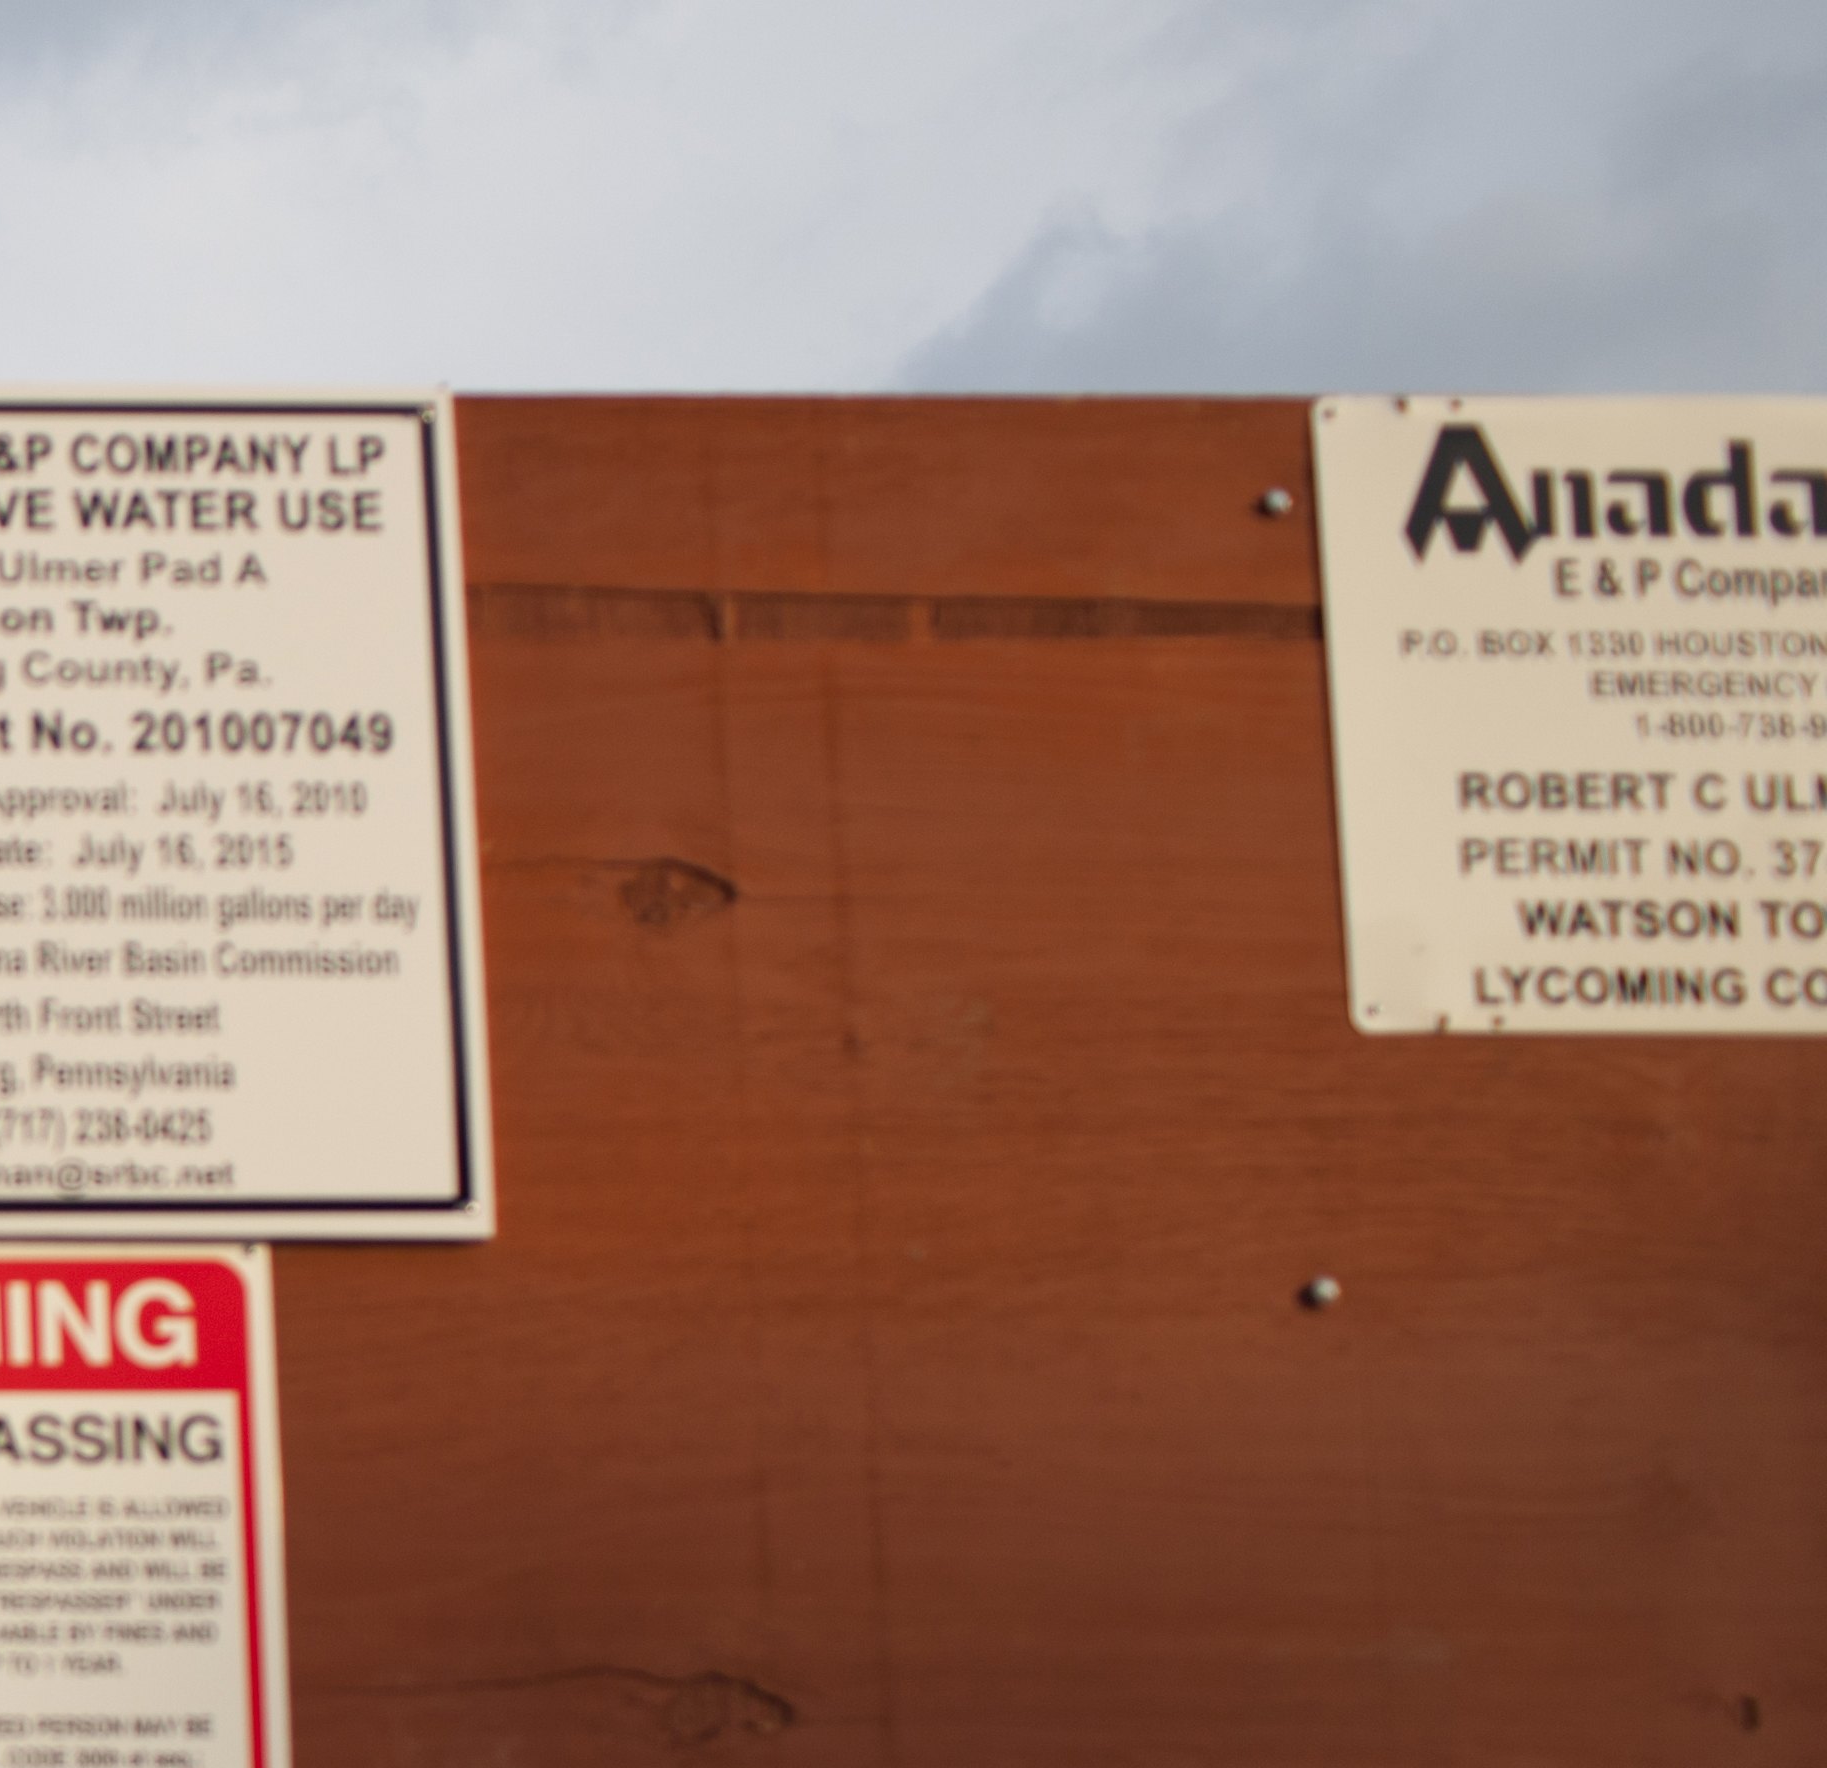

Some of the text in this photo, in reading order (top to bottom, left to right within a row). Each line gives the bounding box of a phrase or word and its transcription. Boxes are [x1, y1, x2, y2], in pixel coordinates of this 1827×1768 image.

[70, 434, 309, 476] COMPANY
[327, 436, 384, 477] LP
[73, 489, 257, 532] WATER
[277, 489, 380, 533] USE
[140, 551, 223, 586] Pad
[235, 554, 265, 586] A
[1554, 556, 1579, 598] E
[1594, 559, 1621, 598] &
[1636, 557, 1661, 596] P
[74, 601, 171, 643] Twp.
[1478, 629, 1554, 660] BOX
[21, 652, 189, 694] County,
[205, 650, 270, 687] Pa.
[1591, 668, 1818, 701] EMERGENCY
[31, 712, 111, 753] No.
[131, 710, 393, 755] 201007049
[157, 783, 222, 824] July
[293, 781, 370, 816] 2010
[1459, 771, 1672, 811] ROBERT
[1693, 772, 1725, 812] C
[74, 836, 141, 876] July
[215, 833, 291, 869] 2015
[1461, 836, 1646, 877] PERMIT
[1667, 837, 1755, 879] NO.
[119, 888, 206, 922] million
[216, 887, 312, 932] gallons
[321, 896, 361, 929] per
[371, 891, 418, 932] day
[1519, 898, 1827, 940] WATSON TO
[36, 942, 112, 976] River
[122, 943, 202, 977] Basin
[214, 942, 396, 977] Commission
[1475, 966, 1827, 1008] LYCOMING CO
[40, 999, 122, 1033] Front
[131, 1000, 218, 1034] Street
[33, 1055, 233, 1098] Pennsylvania
